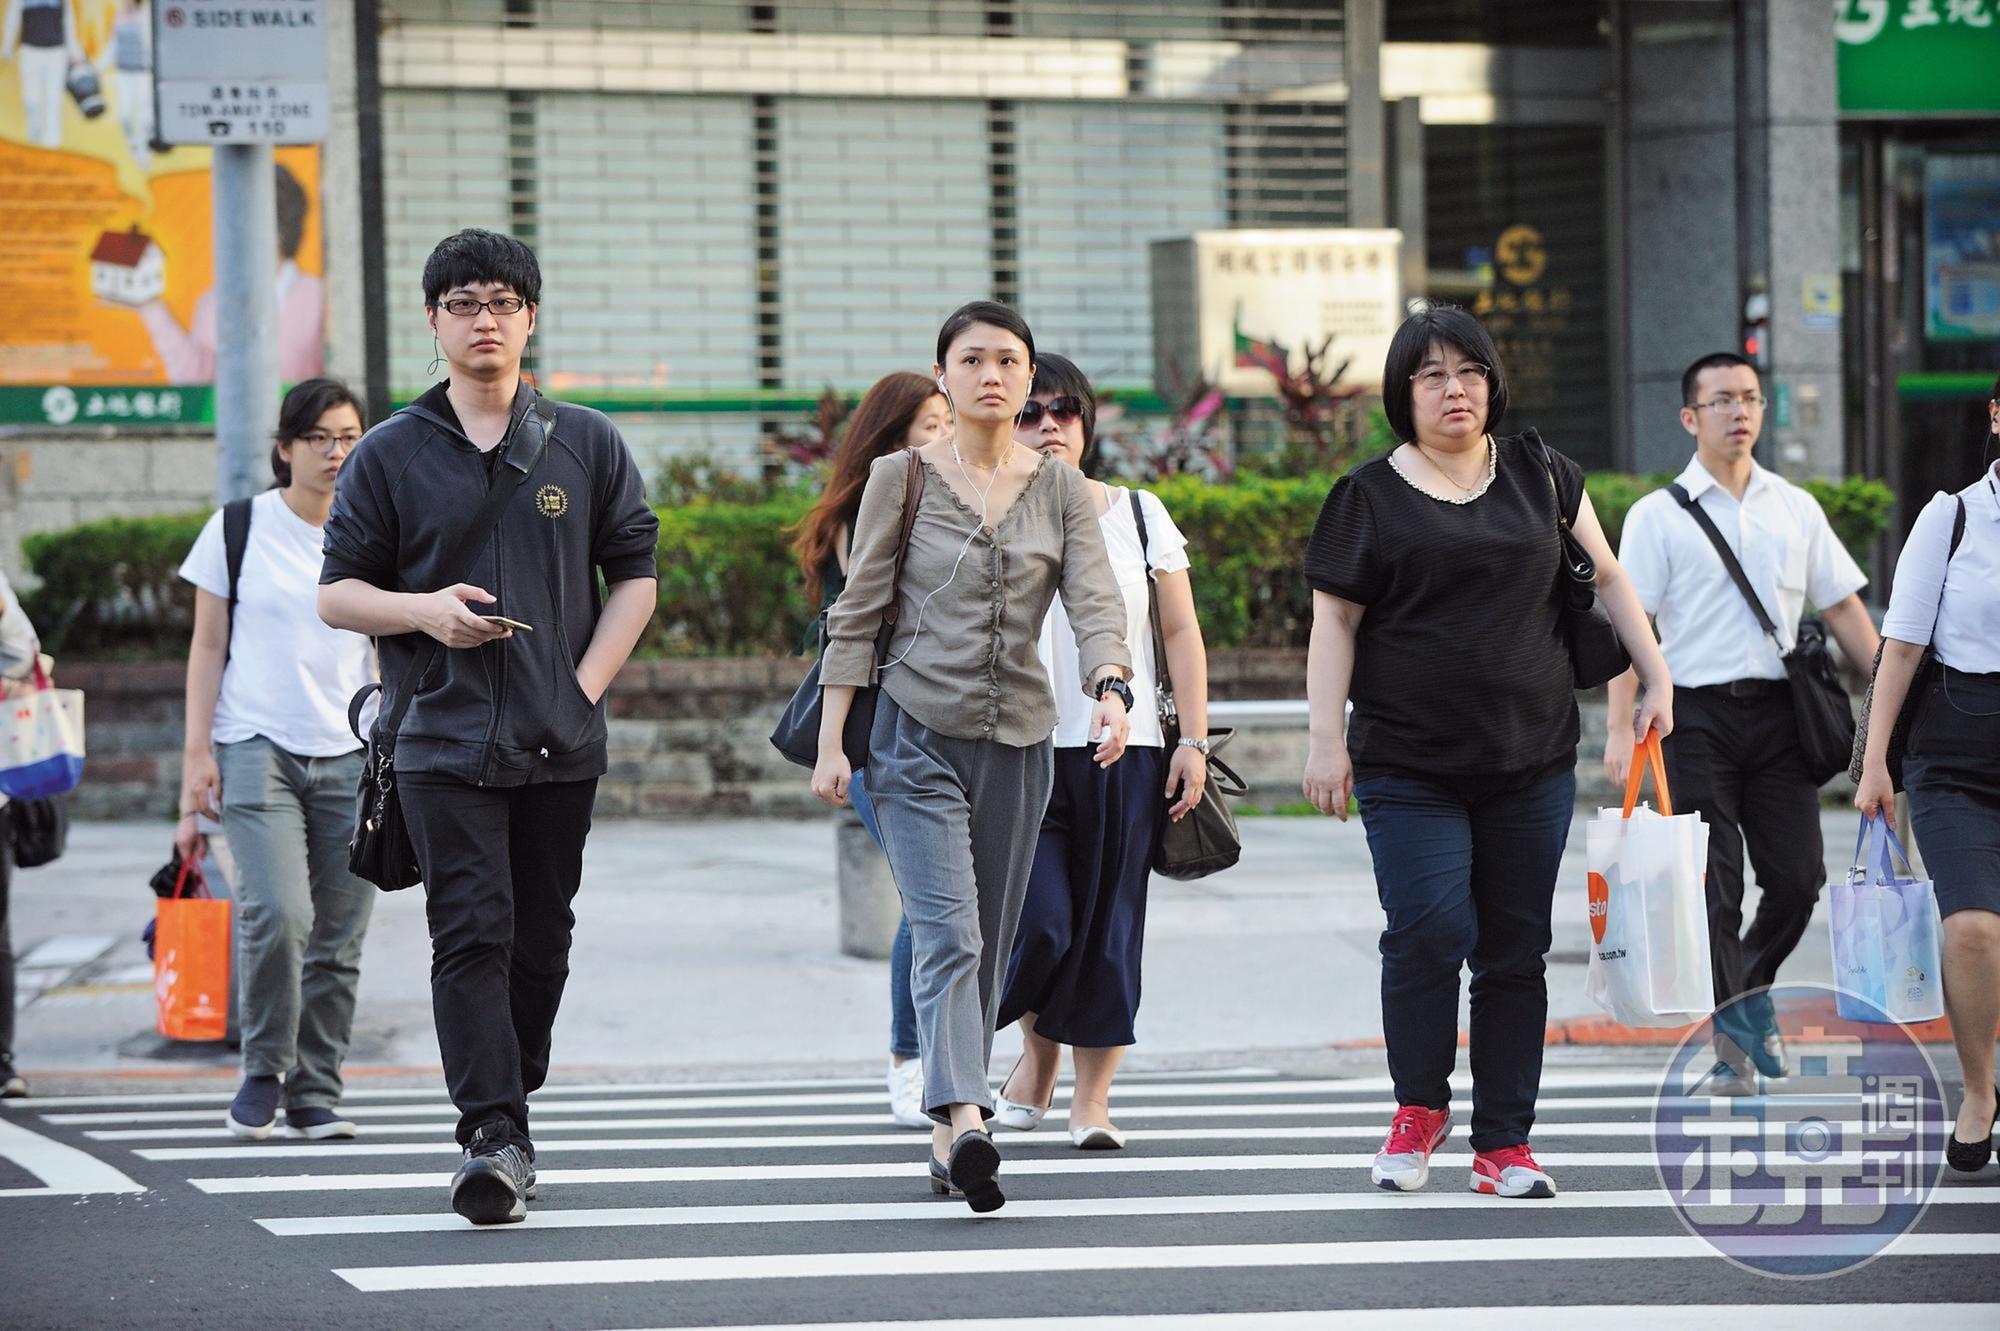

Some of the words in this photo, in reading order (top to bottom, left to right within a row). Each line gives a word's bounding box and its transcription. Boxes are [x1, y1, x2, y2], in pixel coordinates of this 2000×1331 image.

[193, 9, 316, 28] SIDEWALK
[1901, 0, 2000, 30] 土地
[270, 103, 311, 118] ZONE
[248, 121, 286, 136] 110
